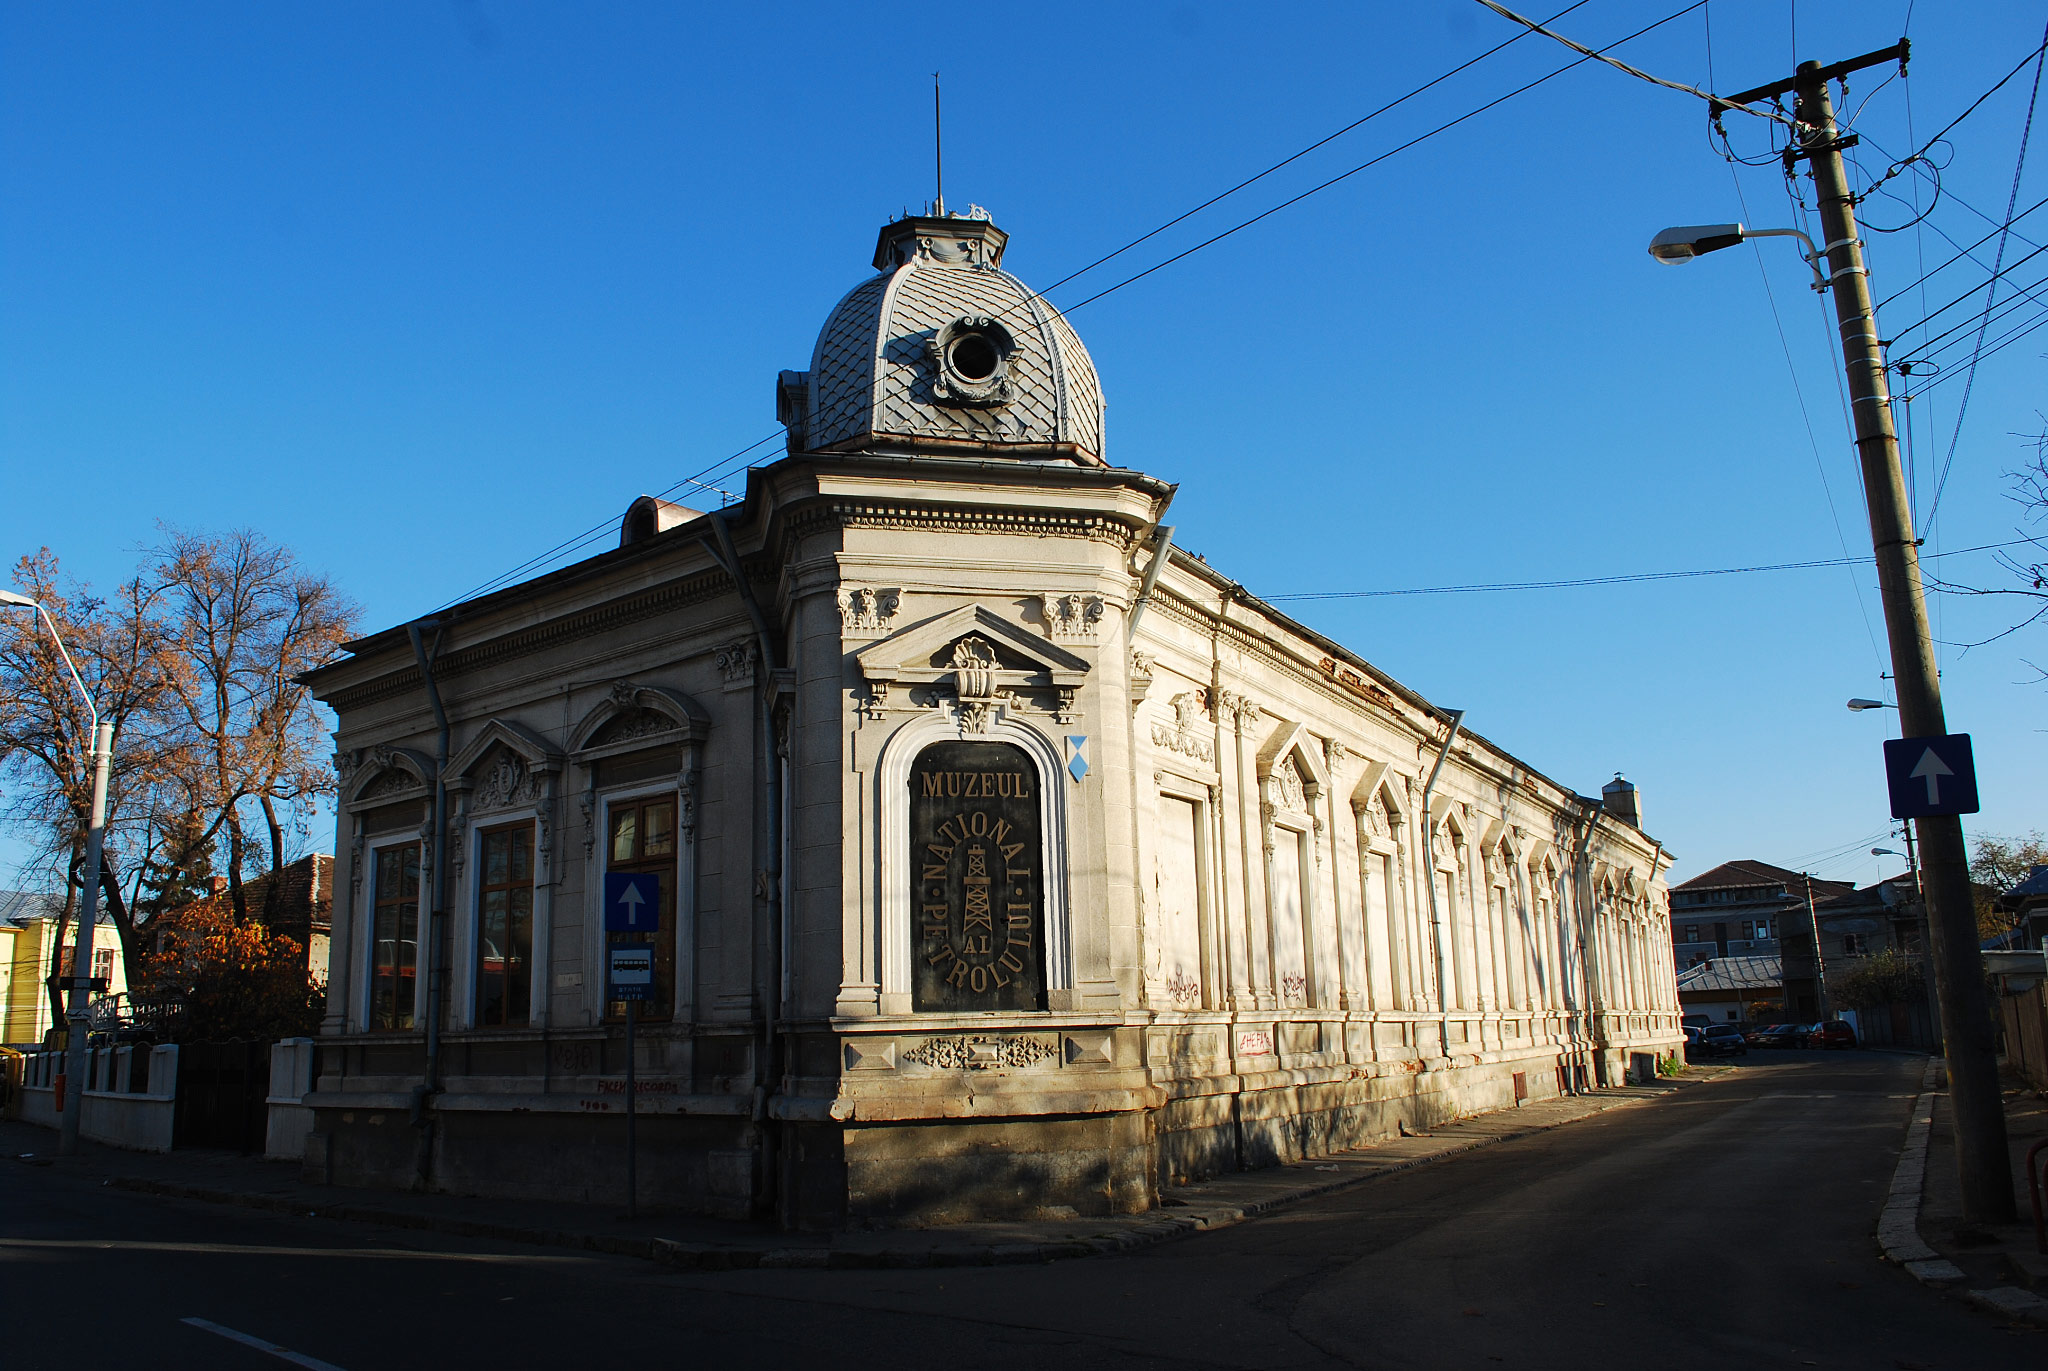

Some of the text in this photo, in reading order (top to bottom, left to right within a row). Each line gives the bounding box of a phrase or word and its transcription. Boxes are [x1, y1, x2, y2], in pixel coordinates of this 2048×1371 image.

[920, 771, 1029, 799] MUZEUL
[921, 811, 1031, 884] NATIONAL
[921, 902, 1033, 993] PETROLULUI
[963, 935, 992, 954] AL
